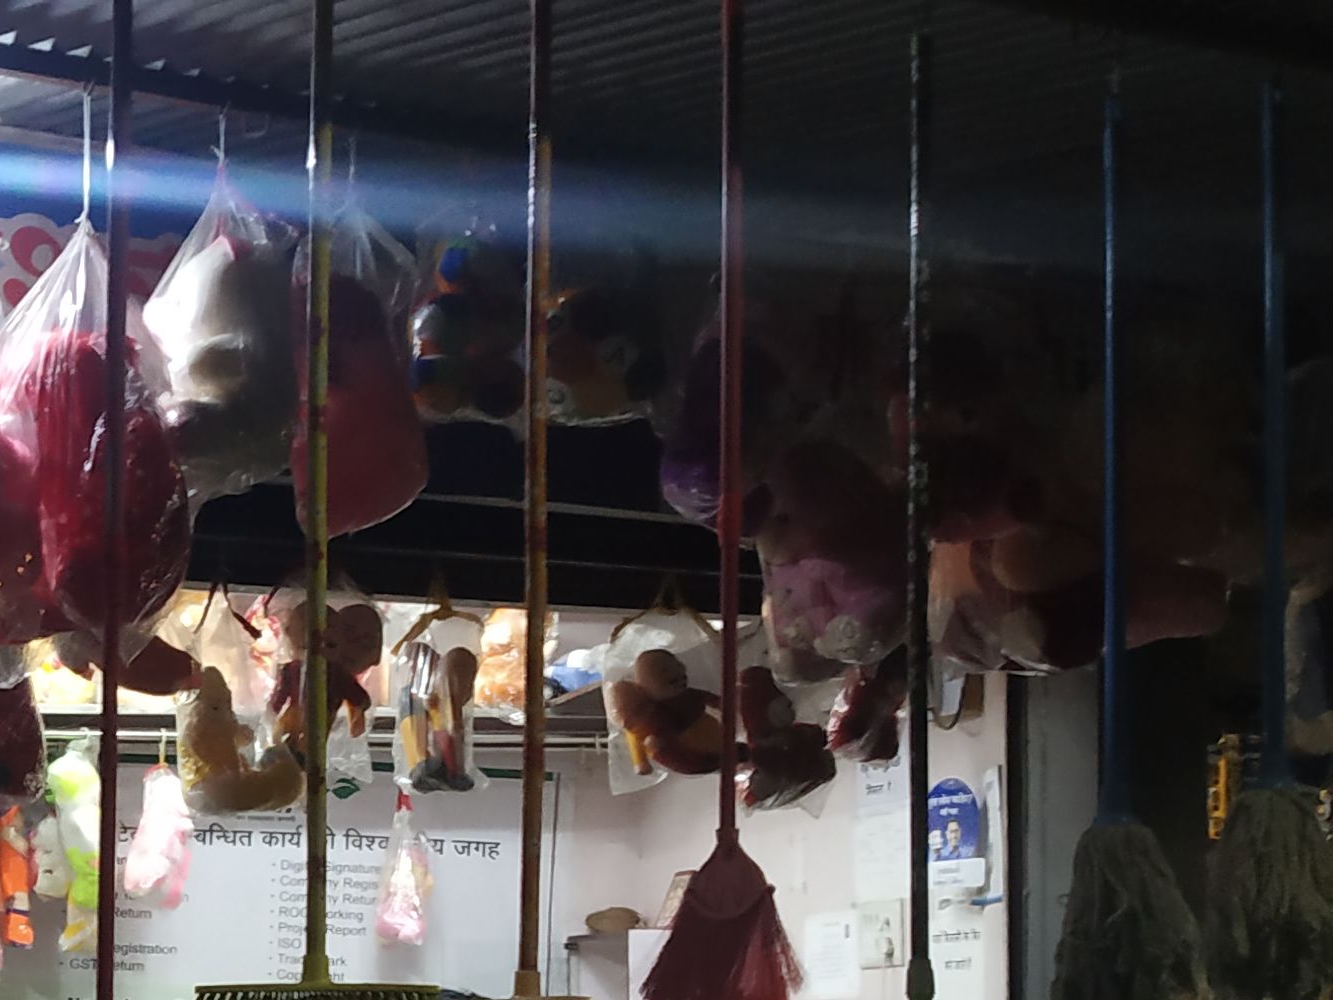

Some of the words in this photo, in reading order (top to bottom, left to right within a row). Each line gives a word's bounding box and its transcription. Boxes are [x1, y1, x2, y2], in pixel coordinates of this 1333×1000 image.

[259, 824, 304, 848] कार्य
[451, 838, 501, 860] जगह
[342, 894, 377, 906] Retur
[325, 911, 364, 923] orking
[112, 943, 179, 957] egistration
[277, 938, 302, 950] ISO
[112, 960, 145, 973] eturn
